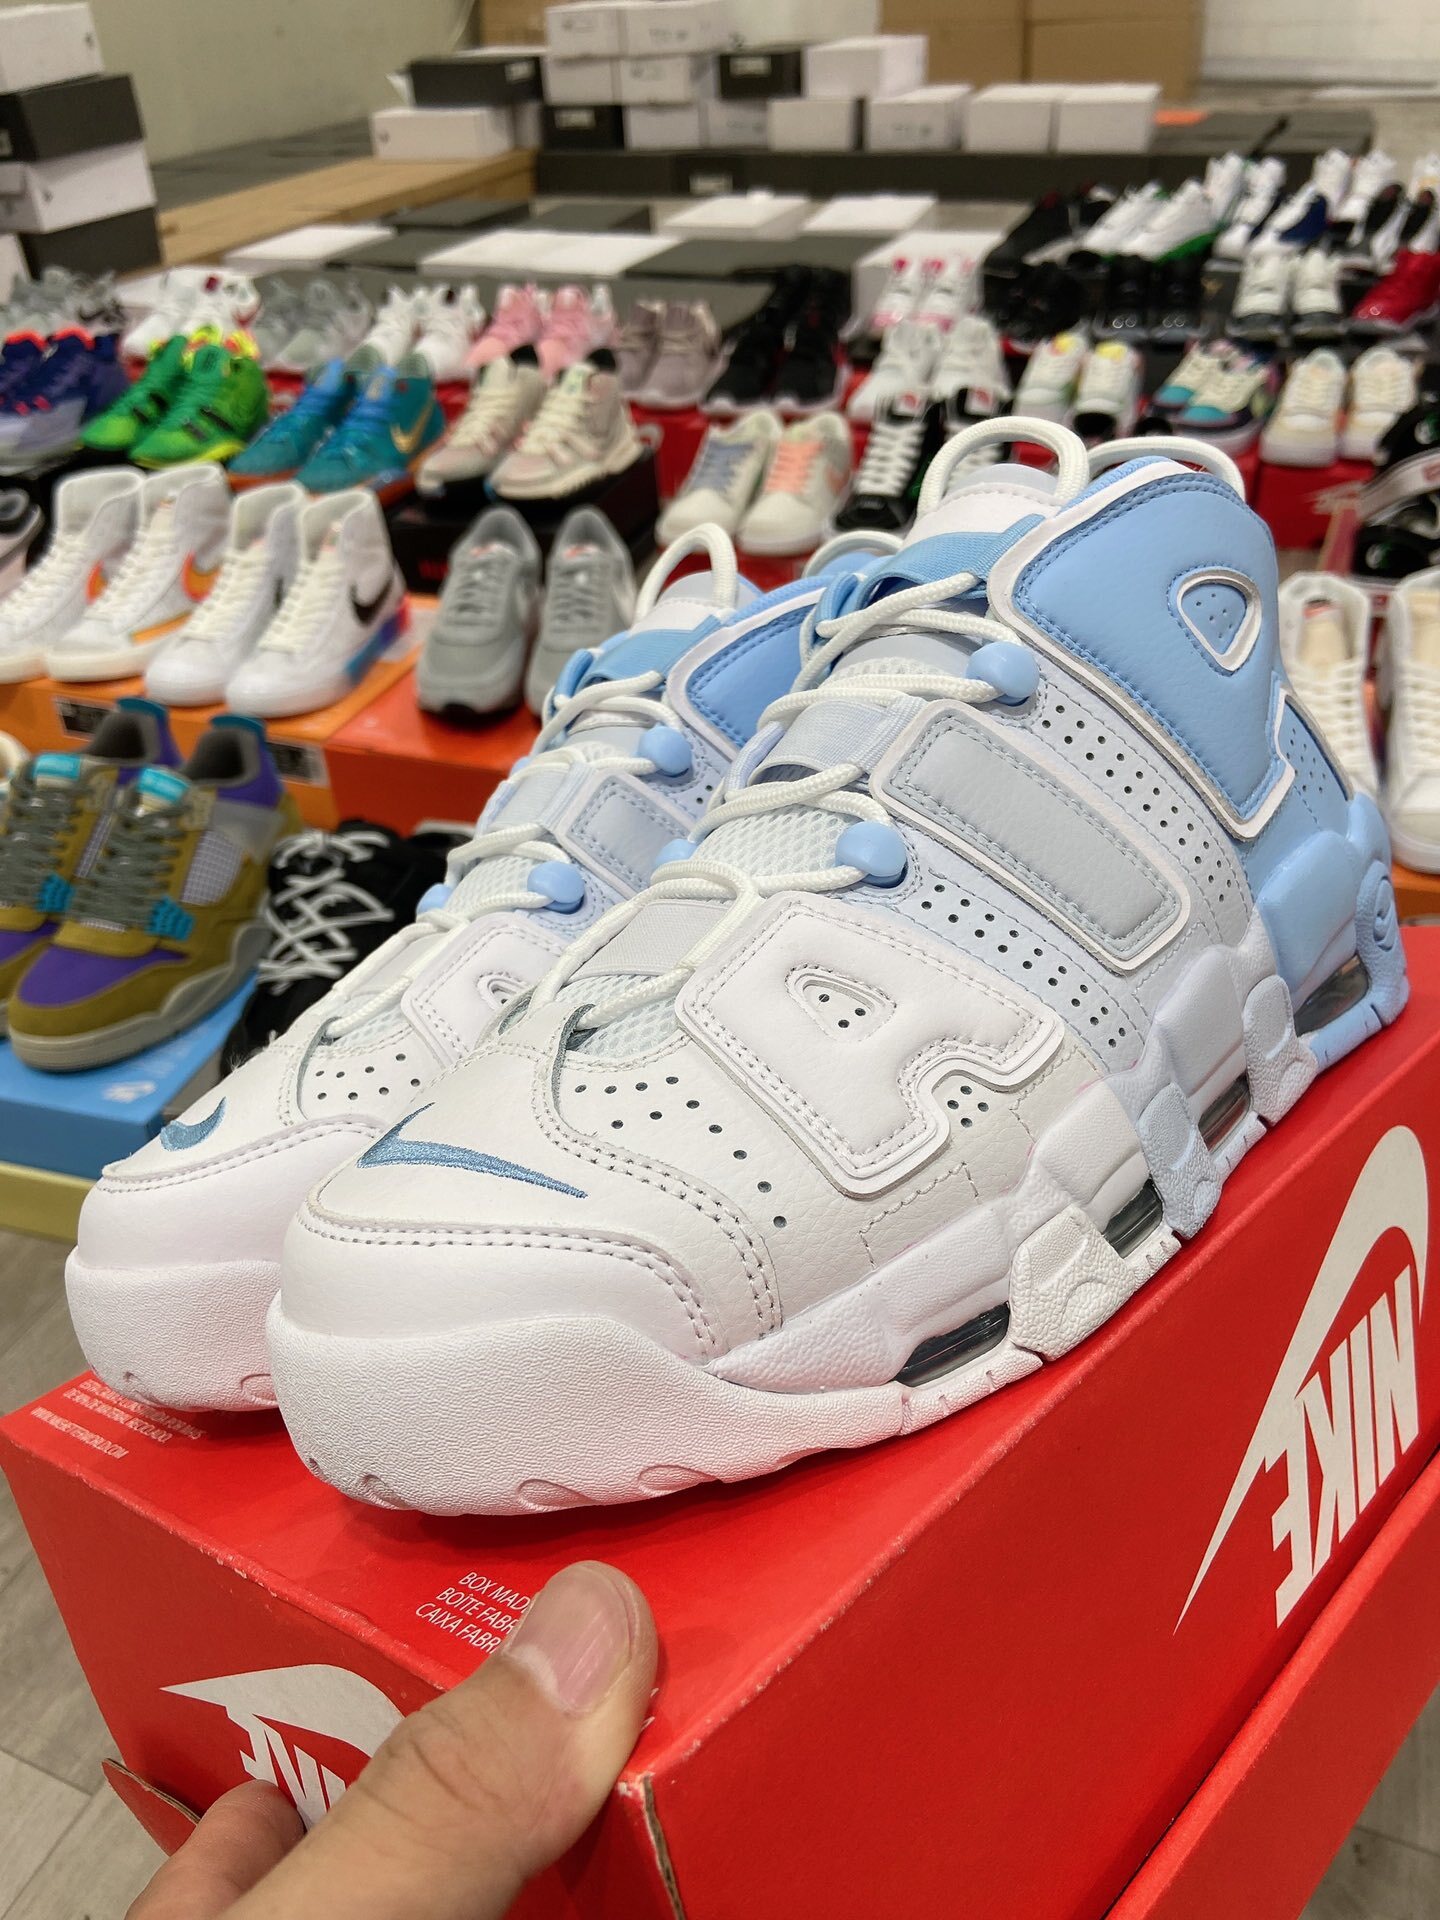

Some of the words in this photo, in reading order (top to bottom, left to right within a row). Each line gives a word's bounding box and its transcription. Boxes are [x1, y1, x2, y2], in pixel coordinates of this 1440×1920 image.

[1271, 1264, 1420, 1629] NIKE
[435, 1587, 486, 1616] BOÎTE
[476, 1606, 520, 1634] FABR
[458, 1571, 498, 1594] BOX
[488, 1585, 531, 1614] MAD
[415, 1602, 463, 1633] CAIXA
